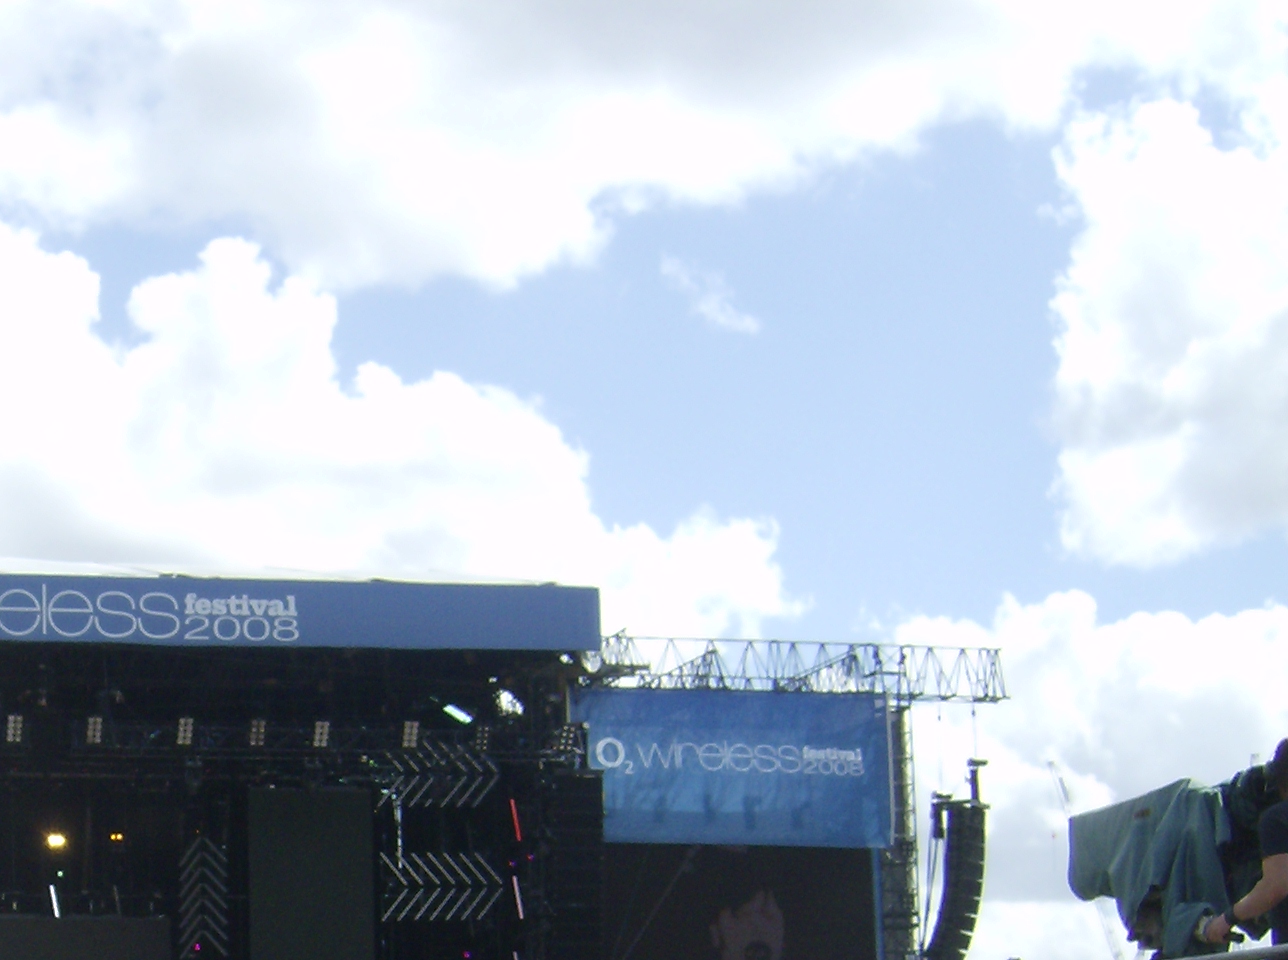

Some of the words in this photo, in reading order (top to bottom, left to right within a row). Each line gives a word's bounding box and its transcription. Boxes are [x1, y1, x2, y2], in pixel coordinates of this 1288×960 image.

[183, 592, 299, 617] festival
[184, 615, 300, 642] 2008
[636, 737, 802, 774] wireless
[802, 759, 865, 777] 2008
